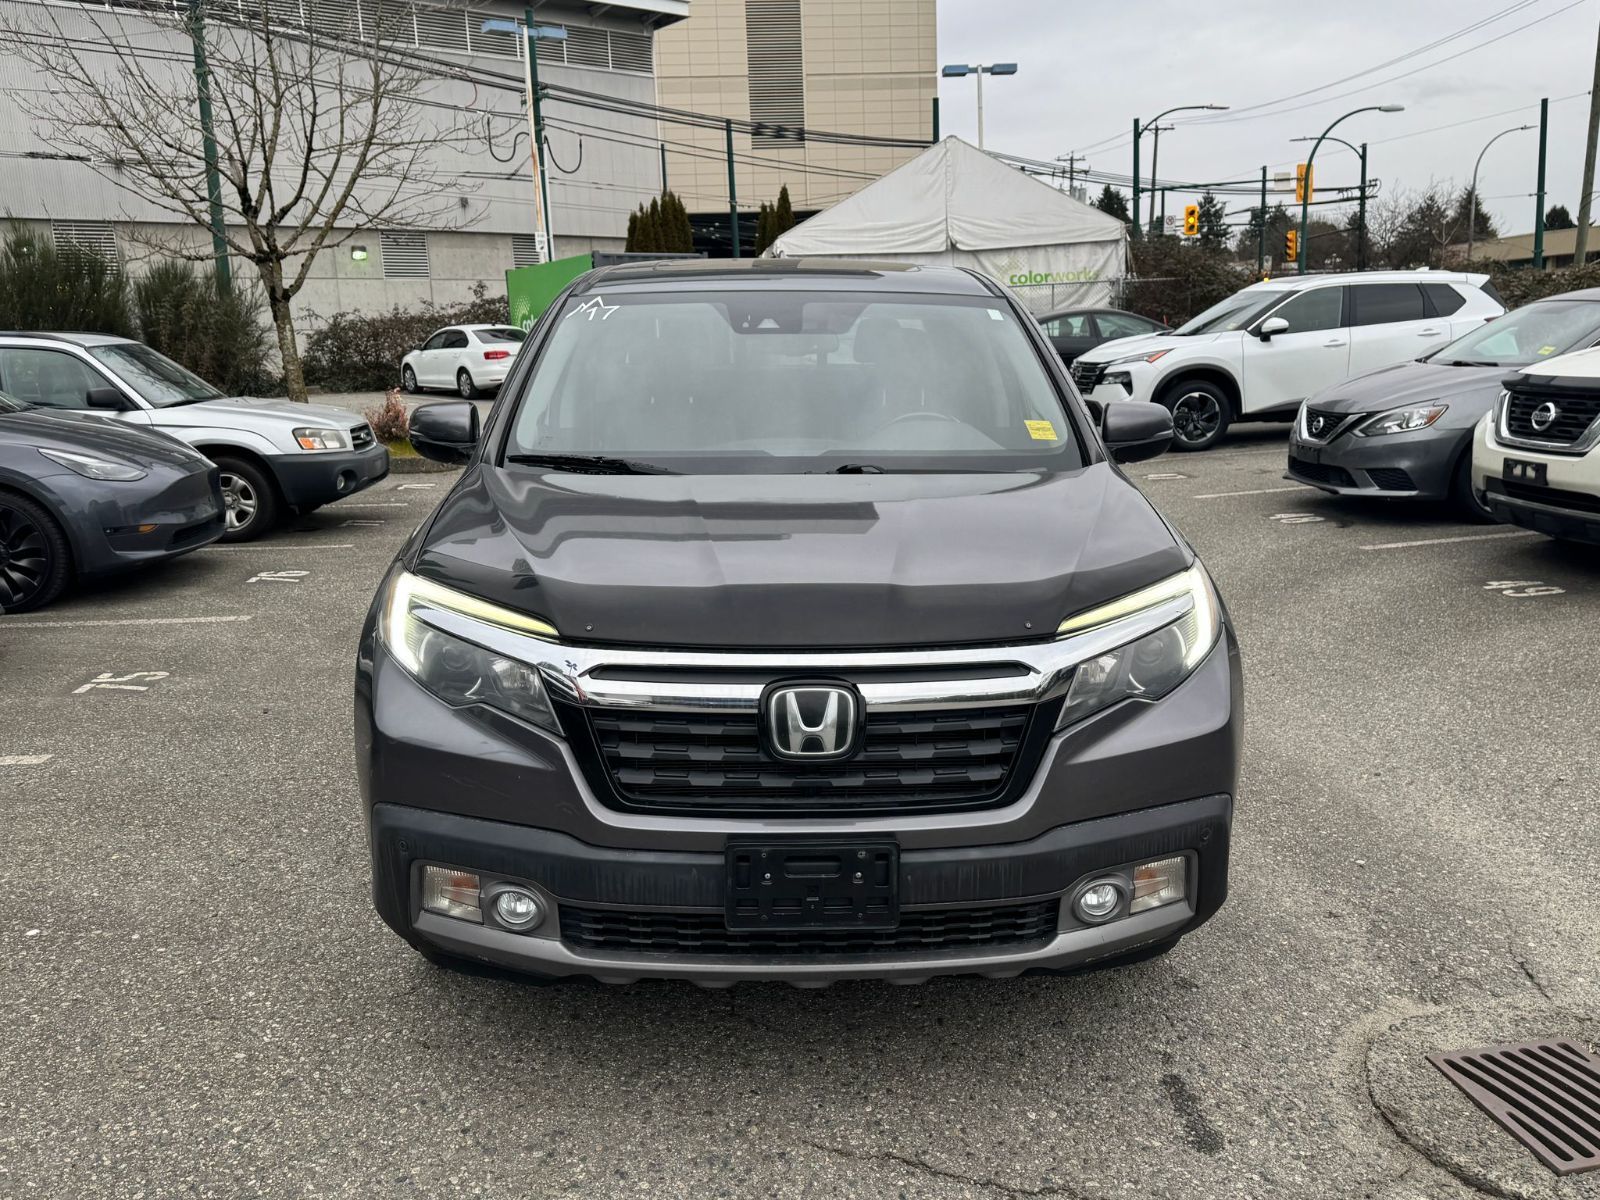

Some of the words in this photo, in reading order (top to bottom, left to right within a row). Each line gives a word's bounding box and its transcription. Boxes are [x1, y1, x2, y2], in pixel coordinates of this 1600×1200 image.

[246, 570, 311, 583] 76
[1483, 580, 1566, 597] 49
[72, 671, 170, 694] 75
